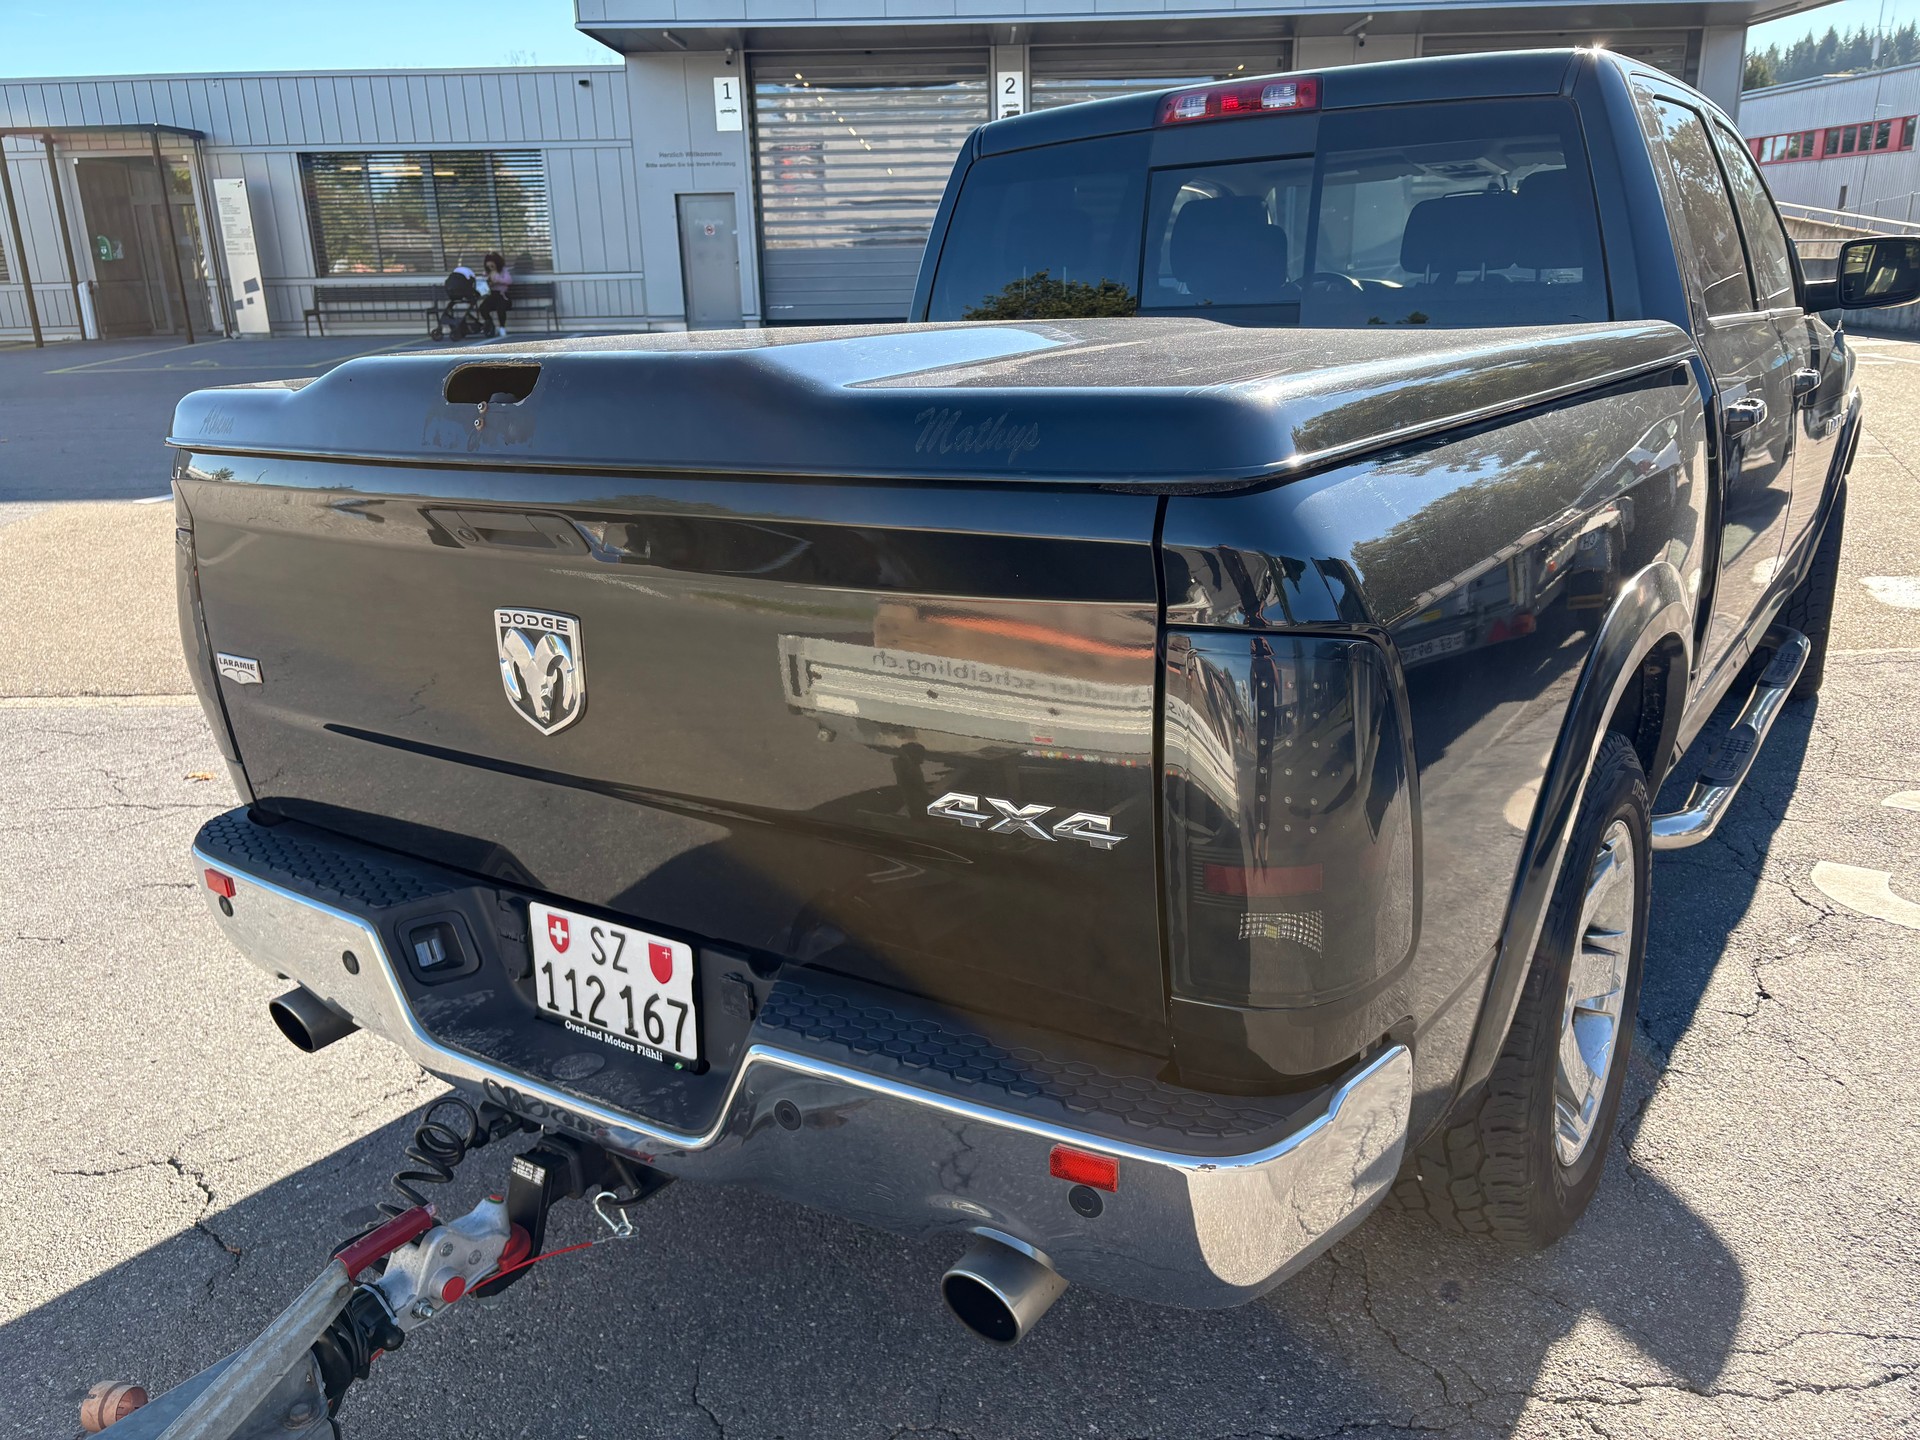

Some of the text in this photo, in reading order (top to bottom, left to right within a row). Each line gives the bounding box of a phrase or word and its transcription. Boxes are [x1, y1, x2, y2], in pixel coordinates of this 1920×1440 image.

[723, 82, 732, 99] 1
[1005, 77, 1015, 94] 2
[914, 407, 1040, 466] Mathys
[499, 613, 568, 632] DODGE
[218, 657, 256, 671] LARAMIE
[927, 792, 1128, 850] 4X4
[590, 926, 628, 974] SZ
[541, 961, 689, 1053] 112 167
[564, 1020, 663, 1062] Overland Motors Flühli
